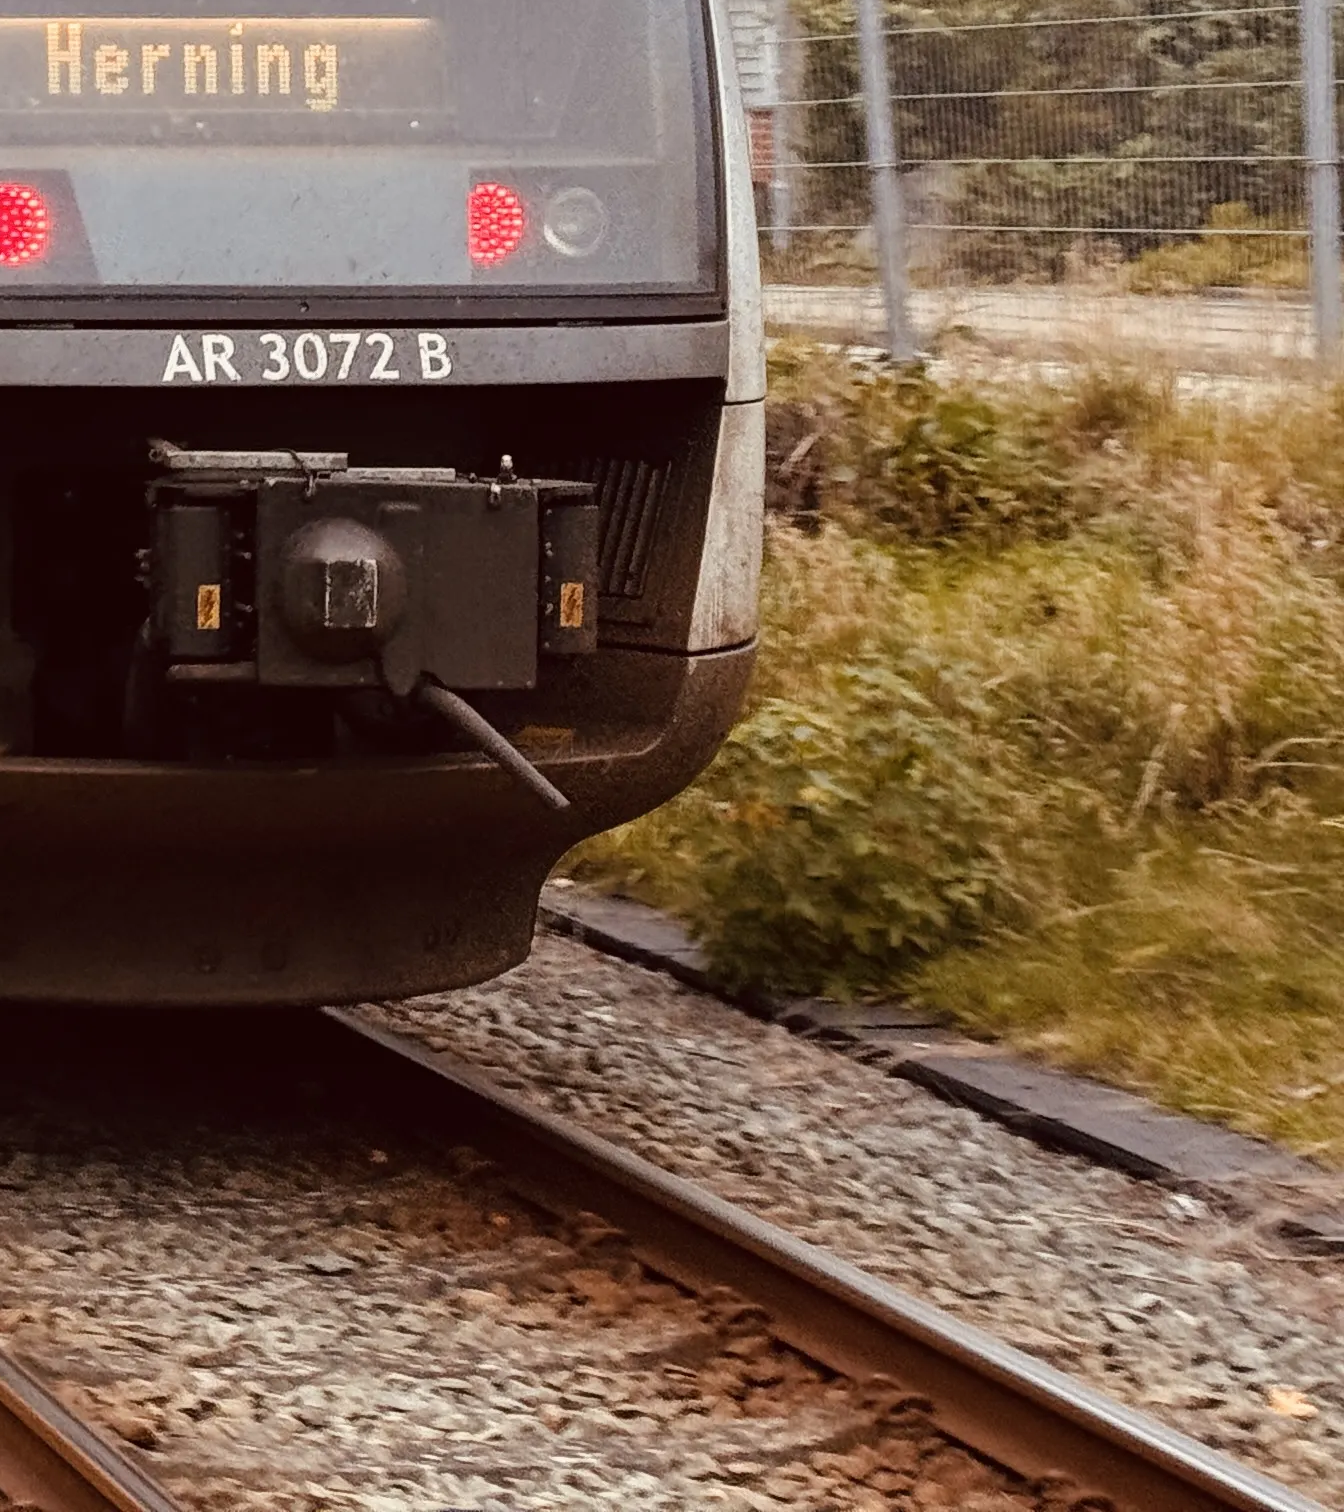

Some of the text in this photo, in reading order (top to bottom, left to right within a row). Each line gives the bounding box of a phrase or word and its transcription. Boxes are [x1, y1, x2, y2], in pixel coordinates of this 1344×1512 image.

[45, 21, 339, 112] Herning
[161, 332, 454, 383] AR 3072 B
